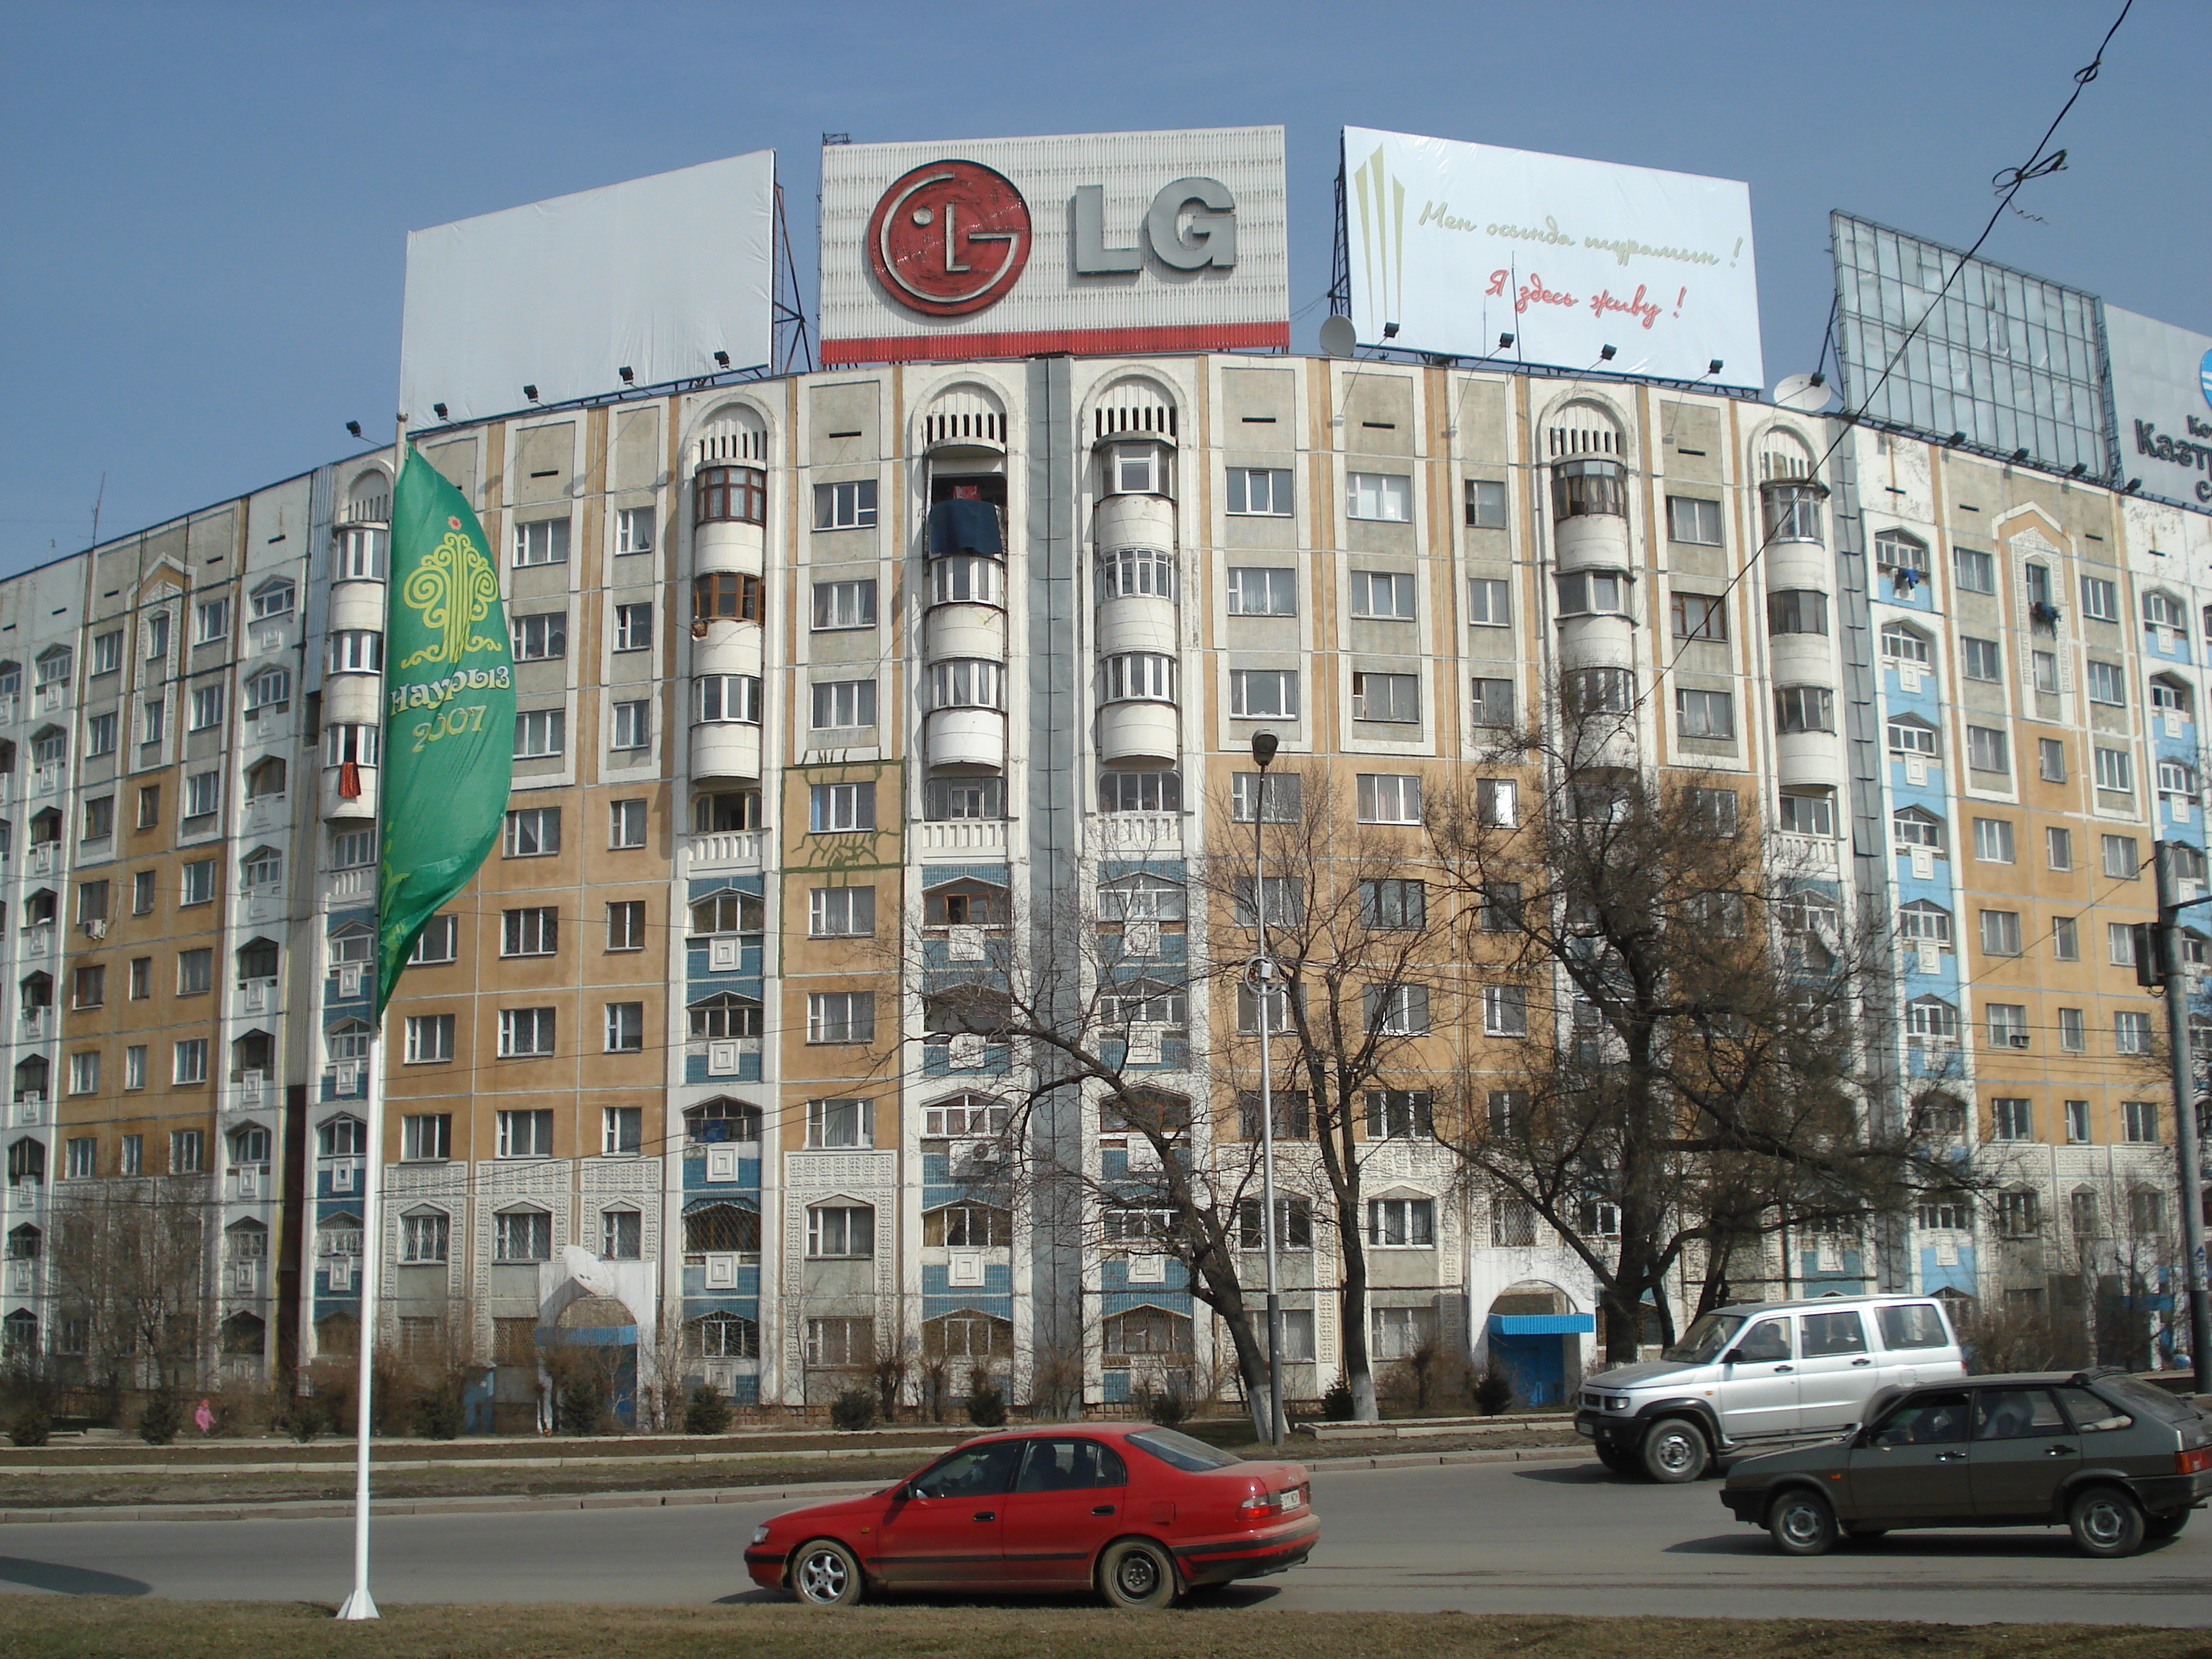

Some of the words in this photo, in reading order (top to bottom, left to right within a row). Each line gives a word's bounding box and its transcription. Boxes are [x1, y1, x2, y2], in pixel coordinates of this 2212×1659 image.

[1076, 176, 1236, 274] LG
[1419, 199, 1477, 232] Мен
[1486, 215, 1575, 246] осында
[1485, 269, 1509, 296] Я
[1515, 273, 1578, 313] здесь
[1590, 284, 1662, 329] живу
[2186, 414, 2212, 441] Ко
[390, 665, 511, 716] Наурыз
[411, 705, 487, 753] 2007
